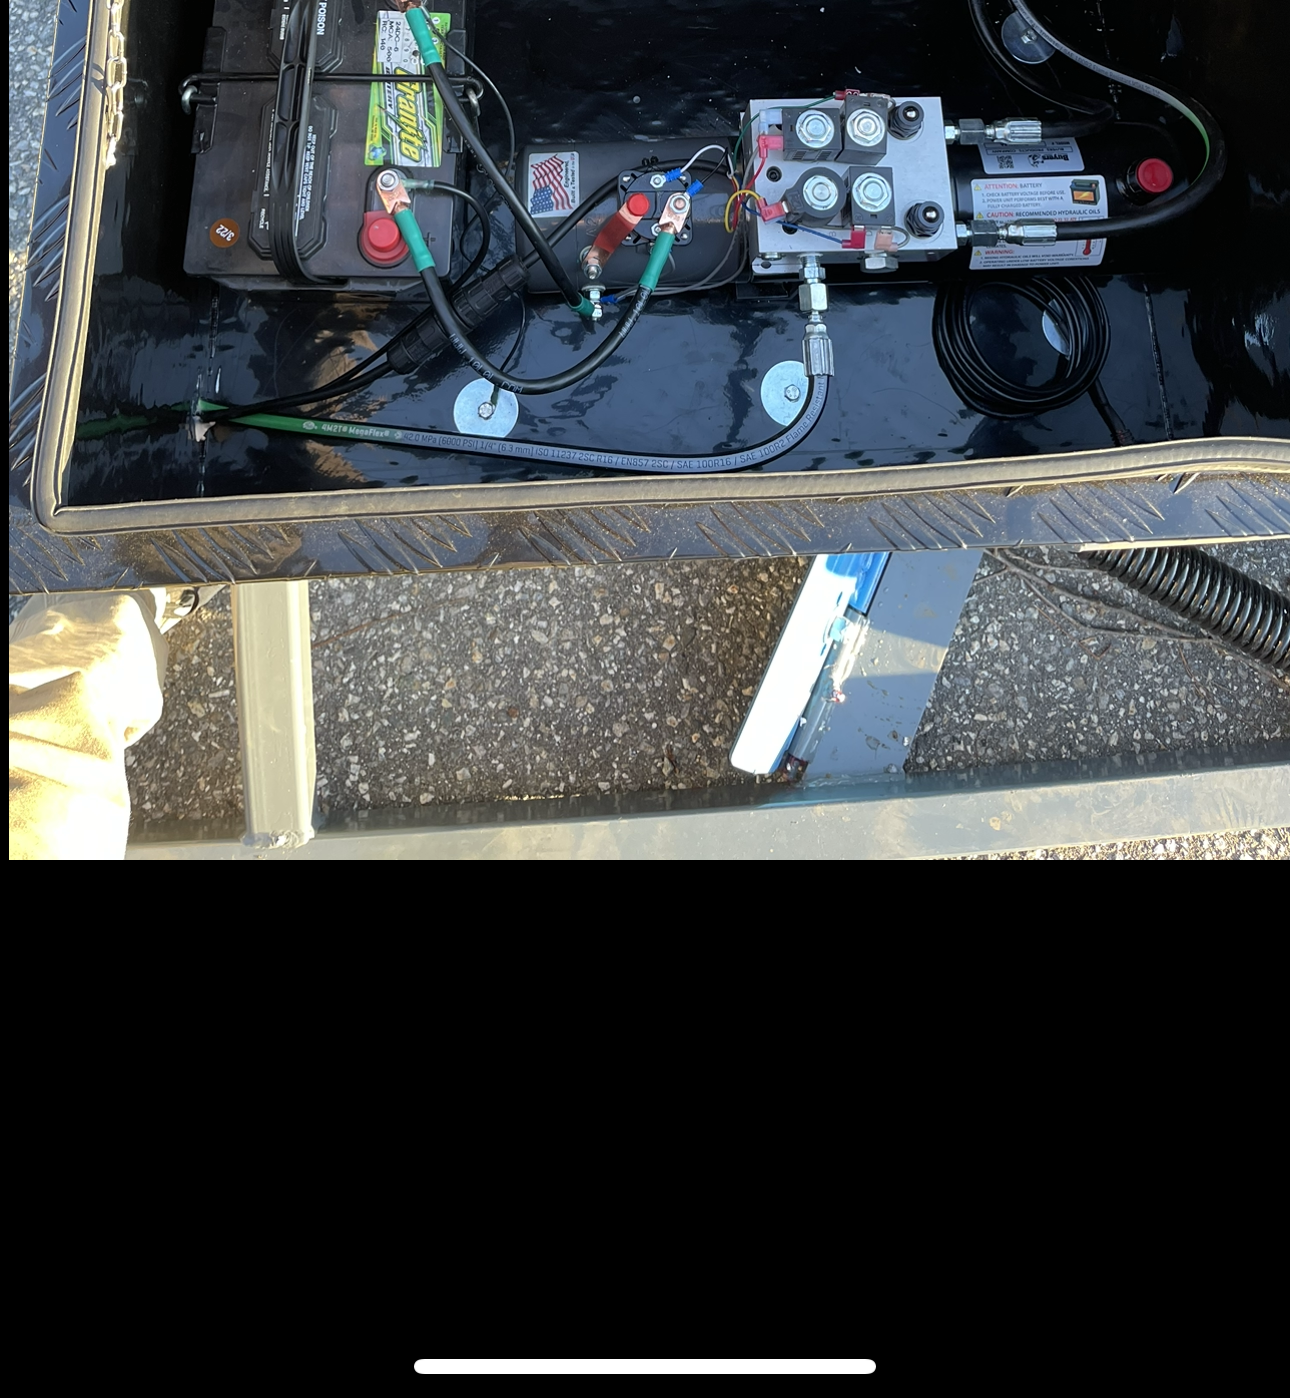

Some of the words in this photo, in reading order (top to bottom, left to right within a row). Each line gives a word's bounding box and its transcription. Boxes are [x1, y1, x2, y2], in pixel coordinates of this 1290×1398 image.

[393, 21, 401, 52] 24DC-6
[395, 66, 426, 163] Granite
[215, 224, 235, 242] 3/22
[422, 435, 437, 444] MPa
[535, 447, 548, 456] ISO
[552, 450, 576, 460] 11237
[578, 452, 595, 462] 2SC
[597, 454, 613, 464] R16
[621, 457, 648, 468] EN857
[651, 459, 669, 468] 2SC
[677, 460, 694, 469] SAE
[696, 458, 731, 469] 100R16
[739, 453, 758, 464] SAE
[759, 439, 786, 458] 100R2
[785, 421, 809, 443] Flame
[806, 382, 824, 422] Resistant
